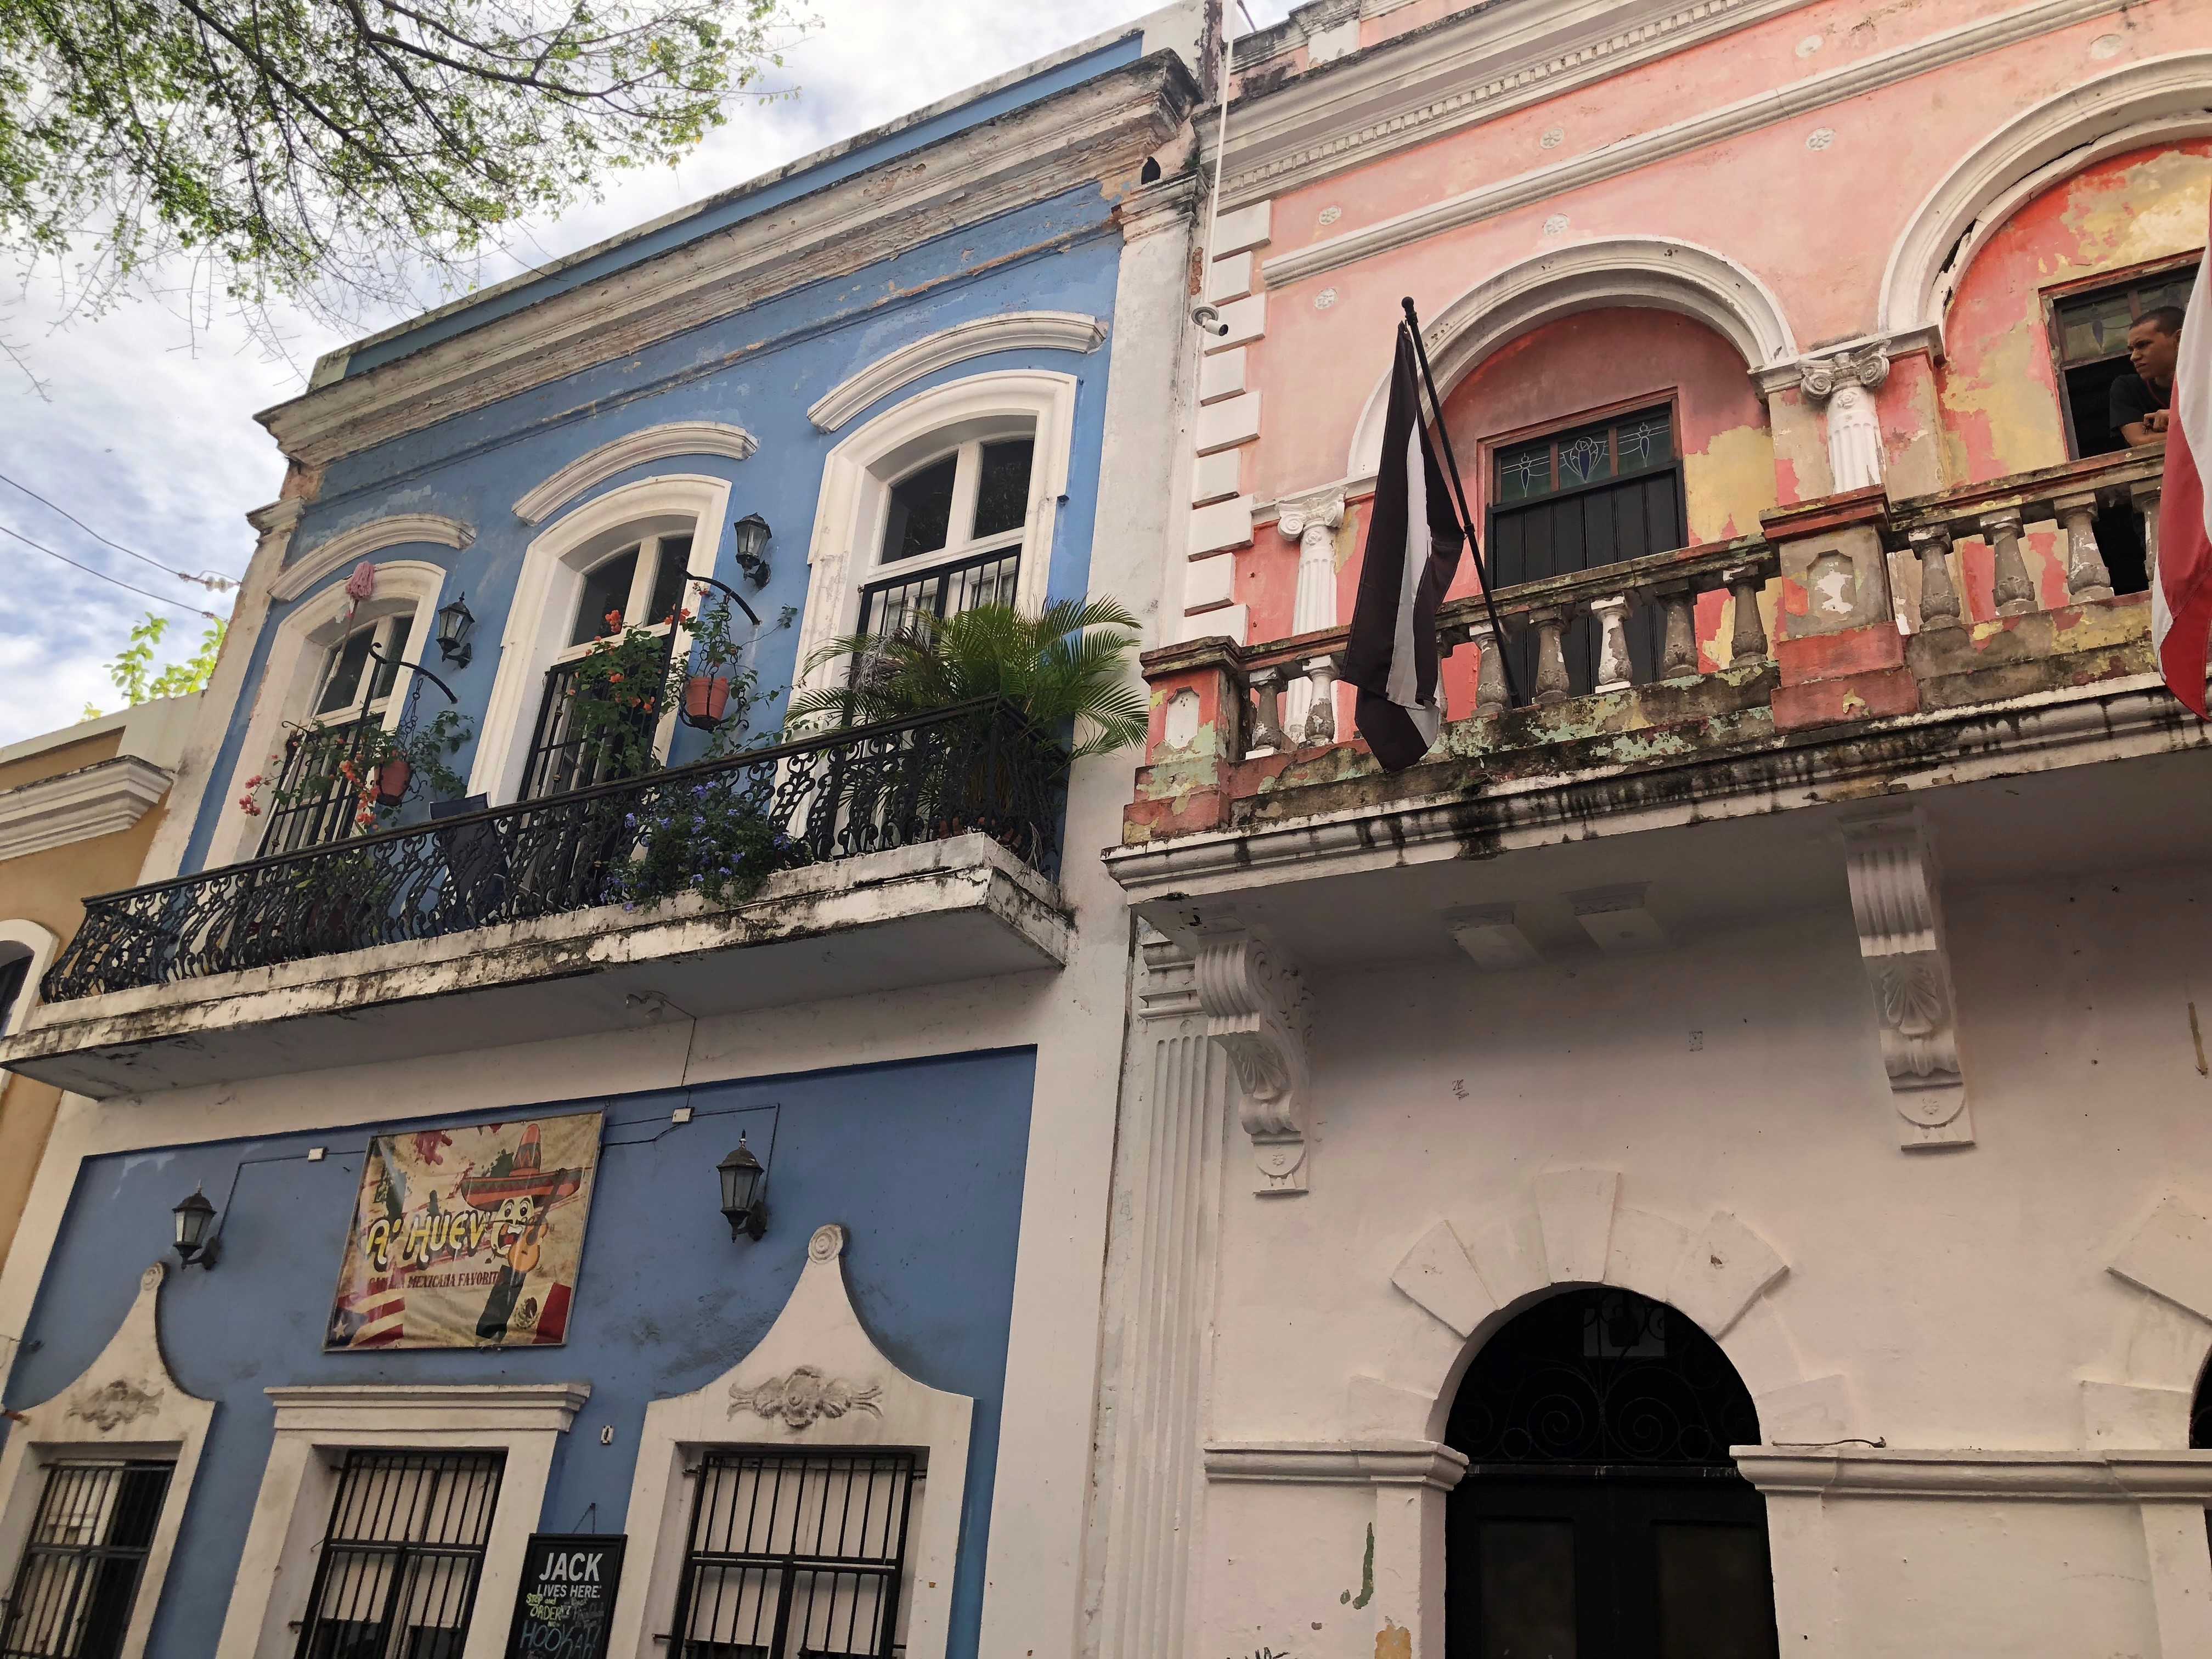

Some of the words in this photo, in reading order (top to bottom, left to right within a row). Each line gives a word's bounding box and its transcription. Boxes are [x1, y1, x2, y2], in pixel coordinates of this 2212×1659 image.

[407, 1273, 456, 1288] MEXICANA
[458, 1271, 500, 1286] FAVORIT
[539, 1553, 603, 1581] JACK
[537, 1584, 567, 1598] LIVES
